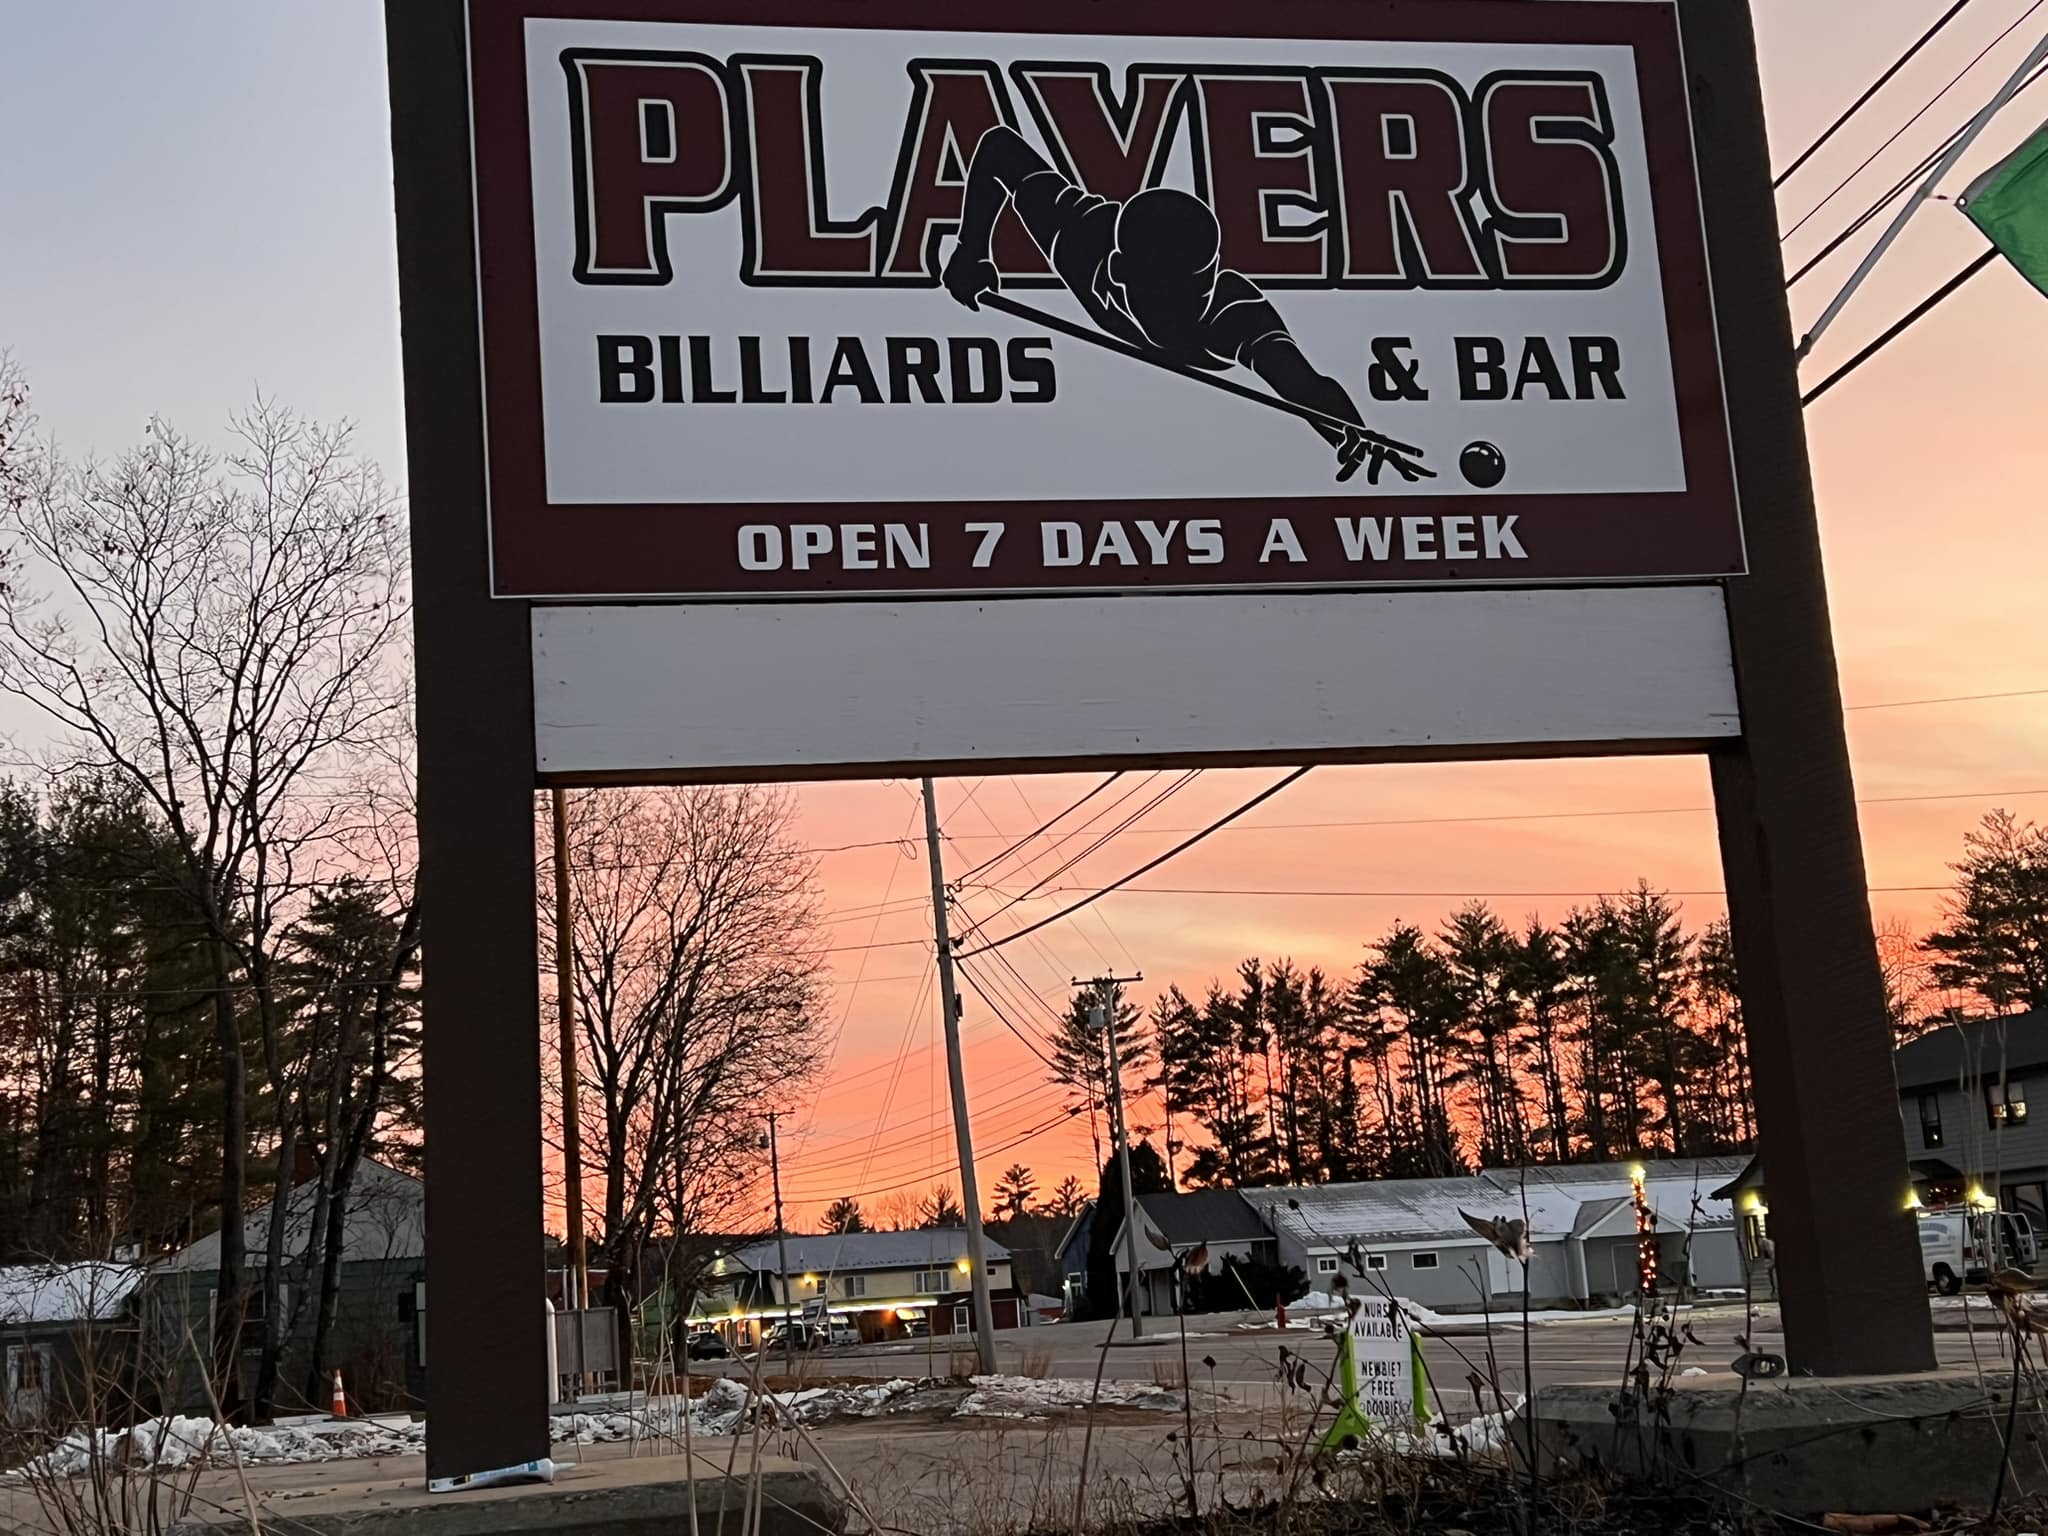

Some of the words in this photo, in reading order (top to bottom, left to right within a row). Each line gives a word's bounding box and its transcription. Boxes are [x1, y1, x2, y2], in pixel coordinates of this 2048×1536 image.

[559, 47, 1628, 290] PLAYERS
[597, 335, 1056, 404] BILLIARDS
[1368, 336, 1428, 402] &
[1454, 336, 1627, 401] BAR
[737, 523, 930, 571] OPEN
[964, 522, 1005, 568] 7
[1040, 519, 1225, 567] DAYS
[1258, 518, 1308, 563] A
[1334, 515, 1529, 561] WEEK
[1364, 1303, 1397, 1318] NURS
[1355, 1321, 1402, 1339] AVAILABE
[1371, 1380, 1394, 1396] FREE
